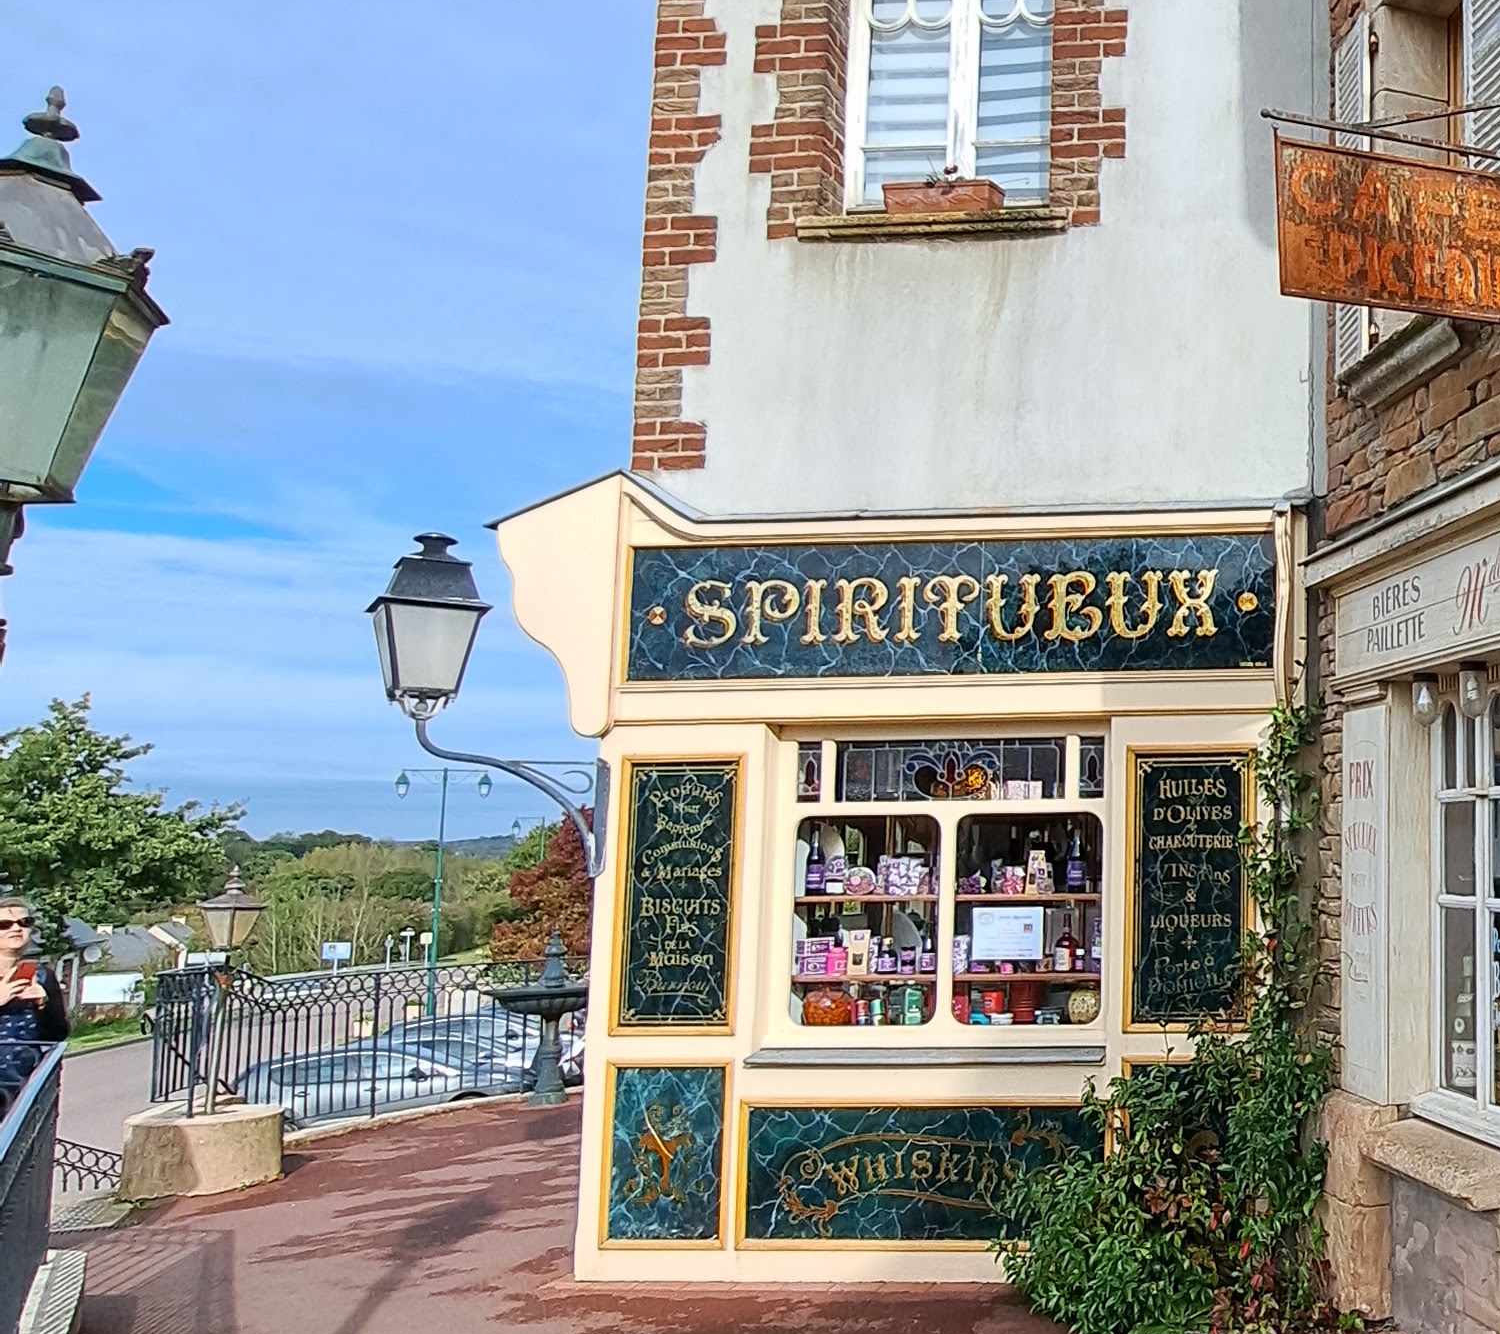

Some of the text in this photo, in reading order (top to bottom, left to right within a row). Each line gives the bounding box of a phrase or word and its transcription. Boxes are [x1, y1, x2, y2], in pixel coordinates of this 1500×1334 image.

[1372, 575, 1421, 621] BIERES
[683, 568, 1219, 649] SPIRITUEUX
[1366, 611, 1425, 653] PAILLETTE
[1159, 779, 1227, 799] HUILES
[1350, 760, 1374, 799] PRIX
[1149, 835, 1233, 849] CHARCUTERIE
[641, 867, 651, 877] &
[1185, 889, 1196, 902] &
[640, 896, 720, 916] BISCUITS
[1150, 913, 1232, 932] LIQUEURS
[679, 940, 691, 949] LA
[649, 950, 714, 966] Maison
